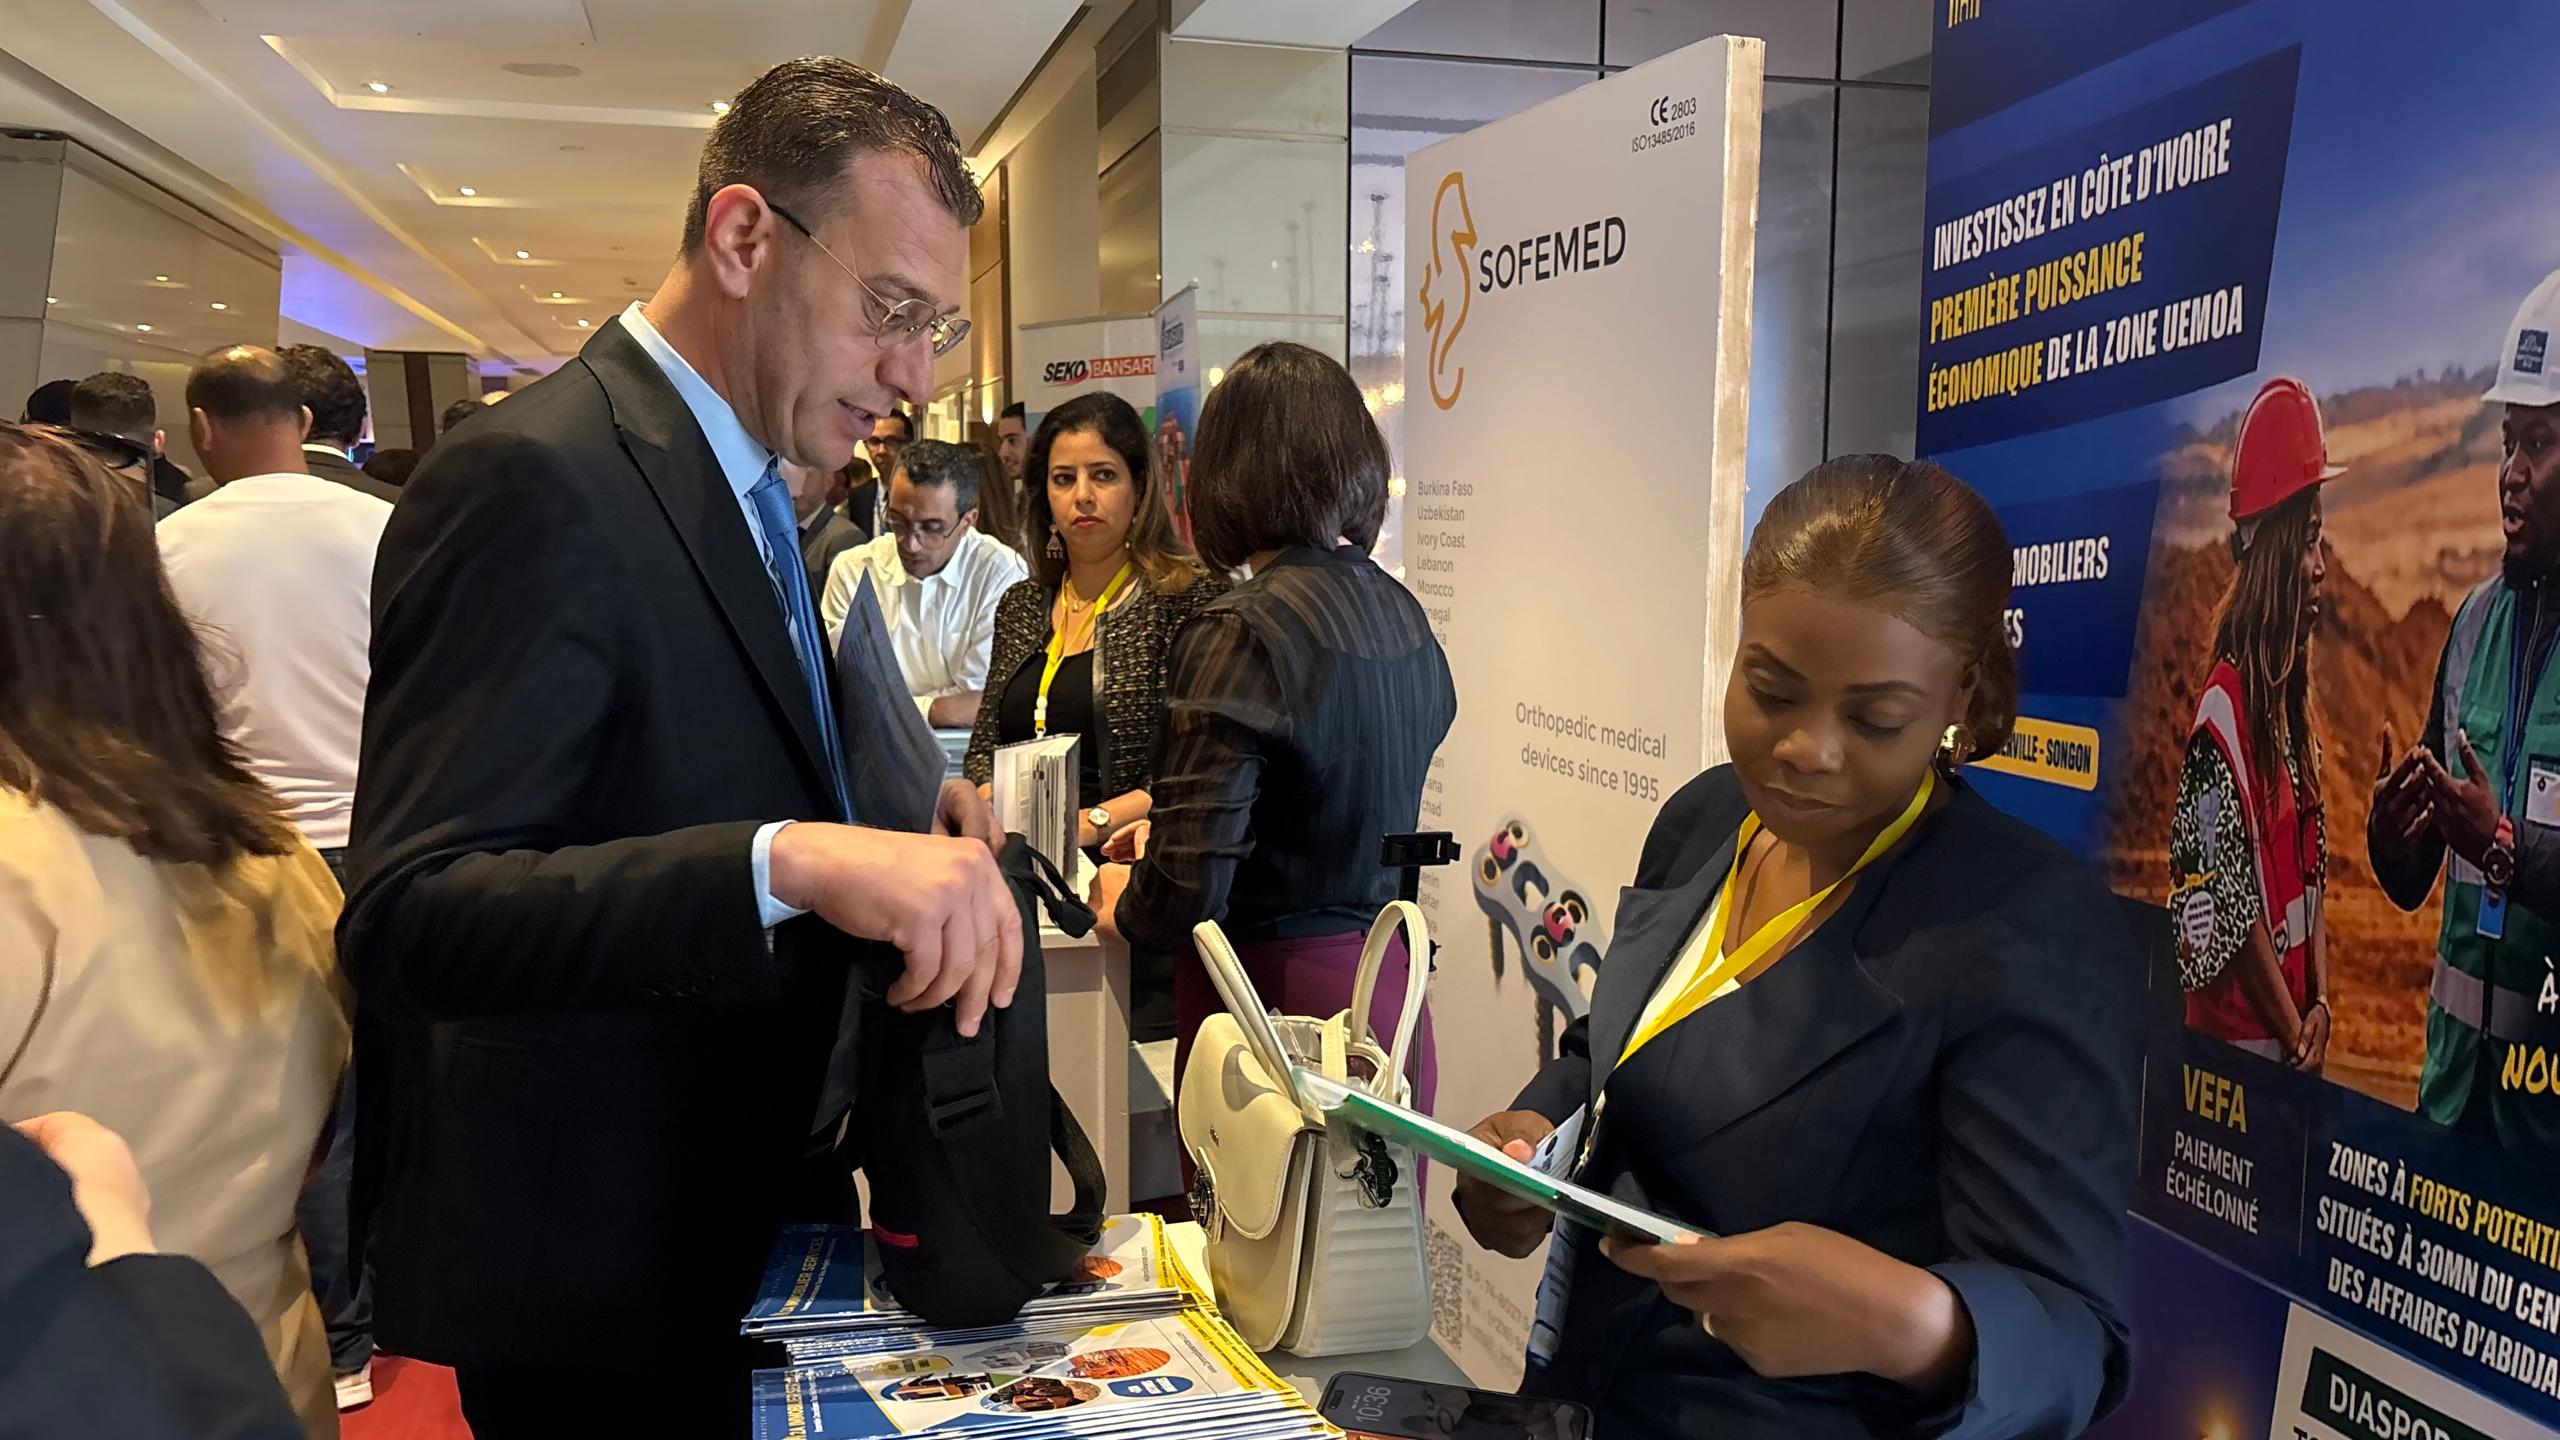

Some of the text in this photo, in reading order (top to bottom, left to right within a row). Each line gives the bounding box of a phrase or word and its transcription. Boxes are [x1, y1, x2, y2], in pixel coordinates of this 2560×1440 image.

[1632, 121, 1696, 153] ISO13485/2016
[1671, 97, 1696, 121] 2803
[1933, 118, 2232, 271] INVESTISSEZ EN CÔTE D'IVOIRE
[1479, 216, 1626, 293] SOFEMED
[1930, 232, 2145, 344] PREMIÈRE PUISSANCE
[1043, 360, 1087, 383] SEKO
[1093, 358, 1154, 377] BANSAR
[1927, 285, 2243, 412] ÉCONOMIQUE DE LA ZONE UEMOA
[1417, 480, 1473, 497] Burkina Faso
[1417, 504, 1465, 522] Uzbekistan
[1417, 531, 1466, 550] Ivory Coast
[1417, 555, 1454, 574] Lebanon
[2012, 536, 2110, 588] MOBILIERS
[1417, 579, 1454, 598] Morocco
[1516, 702, 1666, 759] Orthopedic medical
[2045, 738, 2092, 774] SONGON
[1521, 743, 1660, 802] devices since 1995
[2182, 1063, 2247, 1134] VEFA
[2173, 1129, 2254, 1190] PAIEMENT
[2166, 1162, 2259, 1236] ÉCHÉLONNÉ
[2328, 1140, 2560, 1271] ZONES À FORTS POTENTI
[2316, 1195, 2560, 1335] SITUÉES À 30MN DU CEN
[2327, 1257, 2560, 1400] DES AFFAIRES D'ABIDJA
[1355, 1386, 1392, 1422] 10:36
